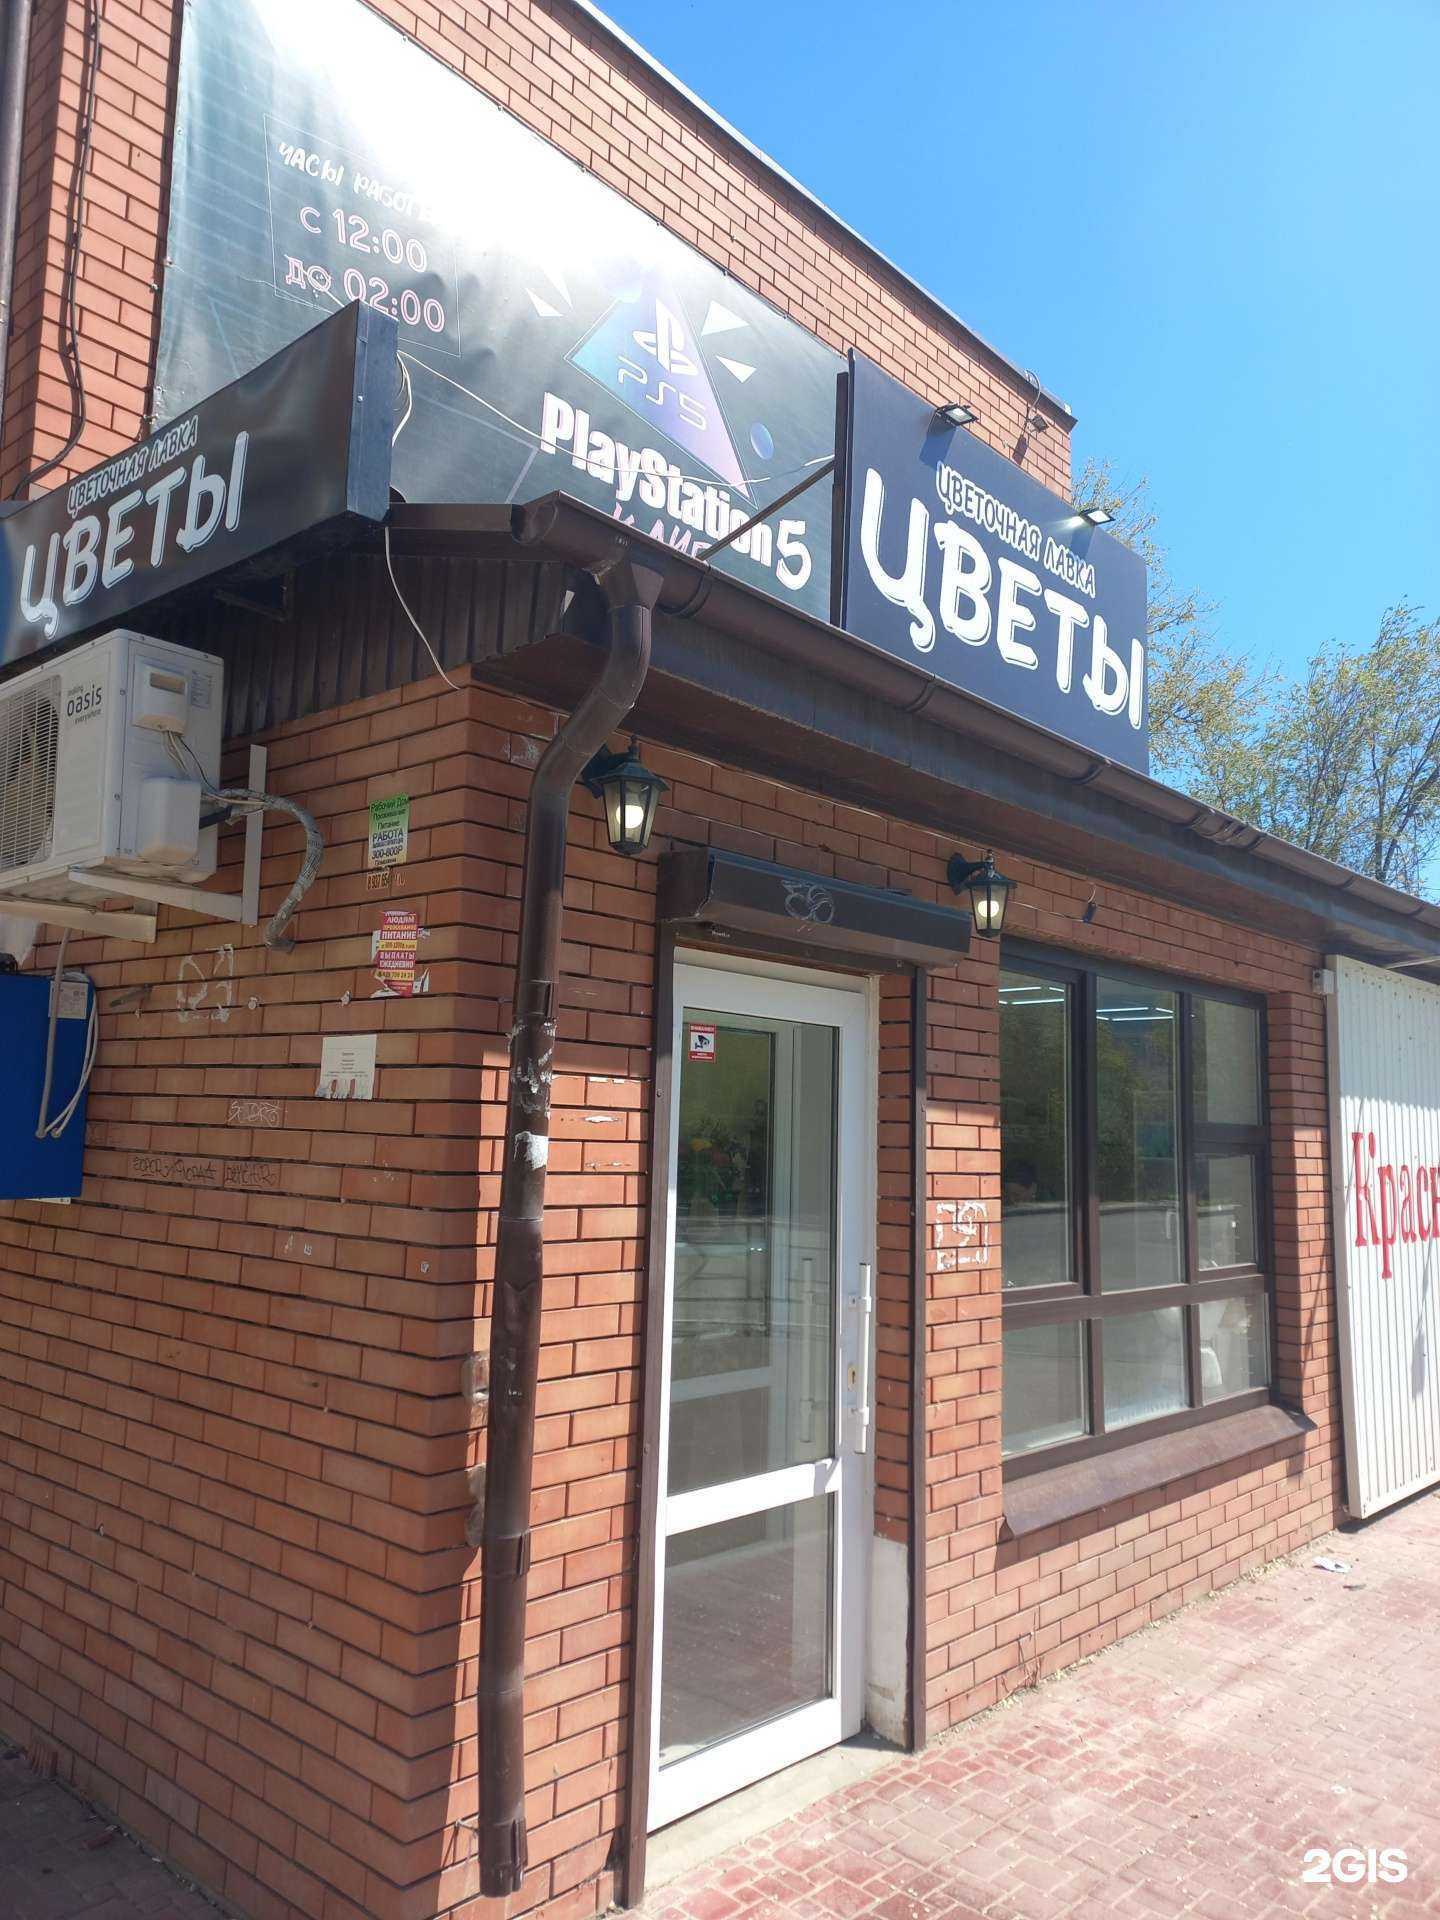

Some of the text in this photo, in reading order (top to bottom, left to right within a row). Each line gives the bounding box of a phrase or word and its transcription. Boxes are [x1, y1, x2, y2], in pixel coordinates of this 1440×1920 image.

[278, 142, 345, 186] ЧАСЫ
[332, 208, 428, 273] 12:00
[343, 268, 445, 333] 02:00
[67, 414, 200, 519] ЦВЕТОЧНАЯ ЛАВКА
[19, 430, 250, 639] ЦВЕТЫ
[935, 460, 1096, 599] ЦВЕТОЧНАЯ ЛАВКА
[860, 468, 1145, 730] ЦВЕТЫ
[67, 683, 102, 717] oasis
[372, 829, 404, 843] РАБОТА
[380, 951, 415, 960] ВЫПЛАТЫ
[381, 930, 417, 940] ПИТАНИЕ
